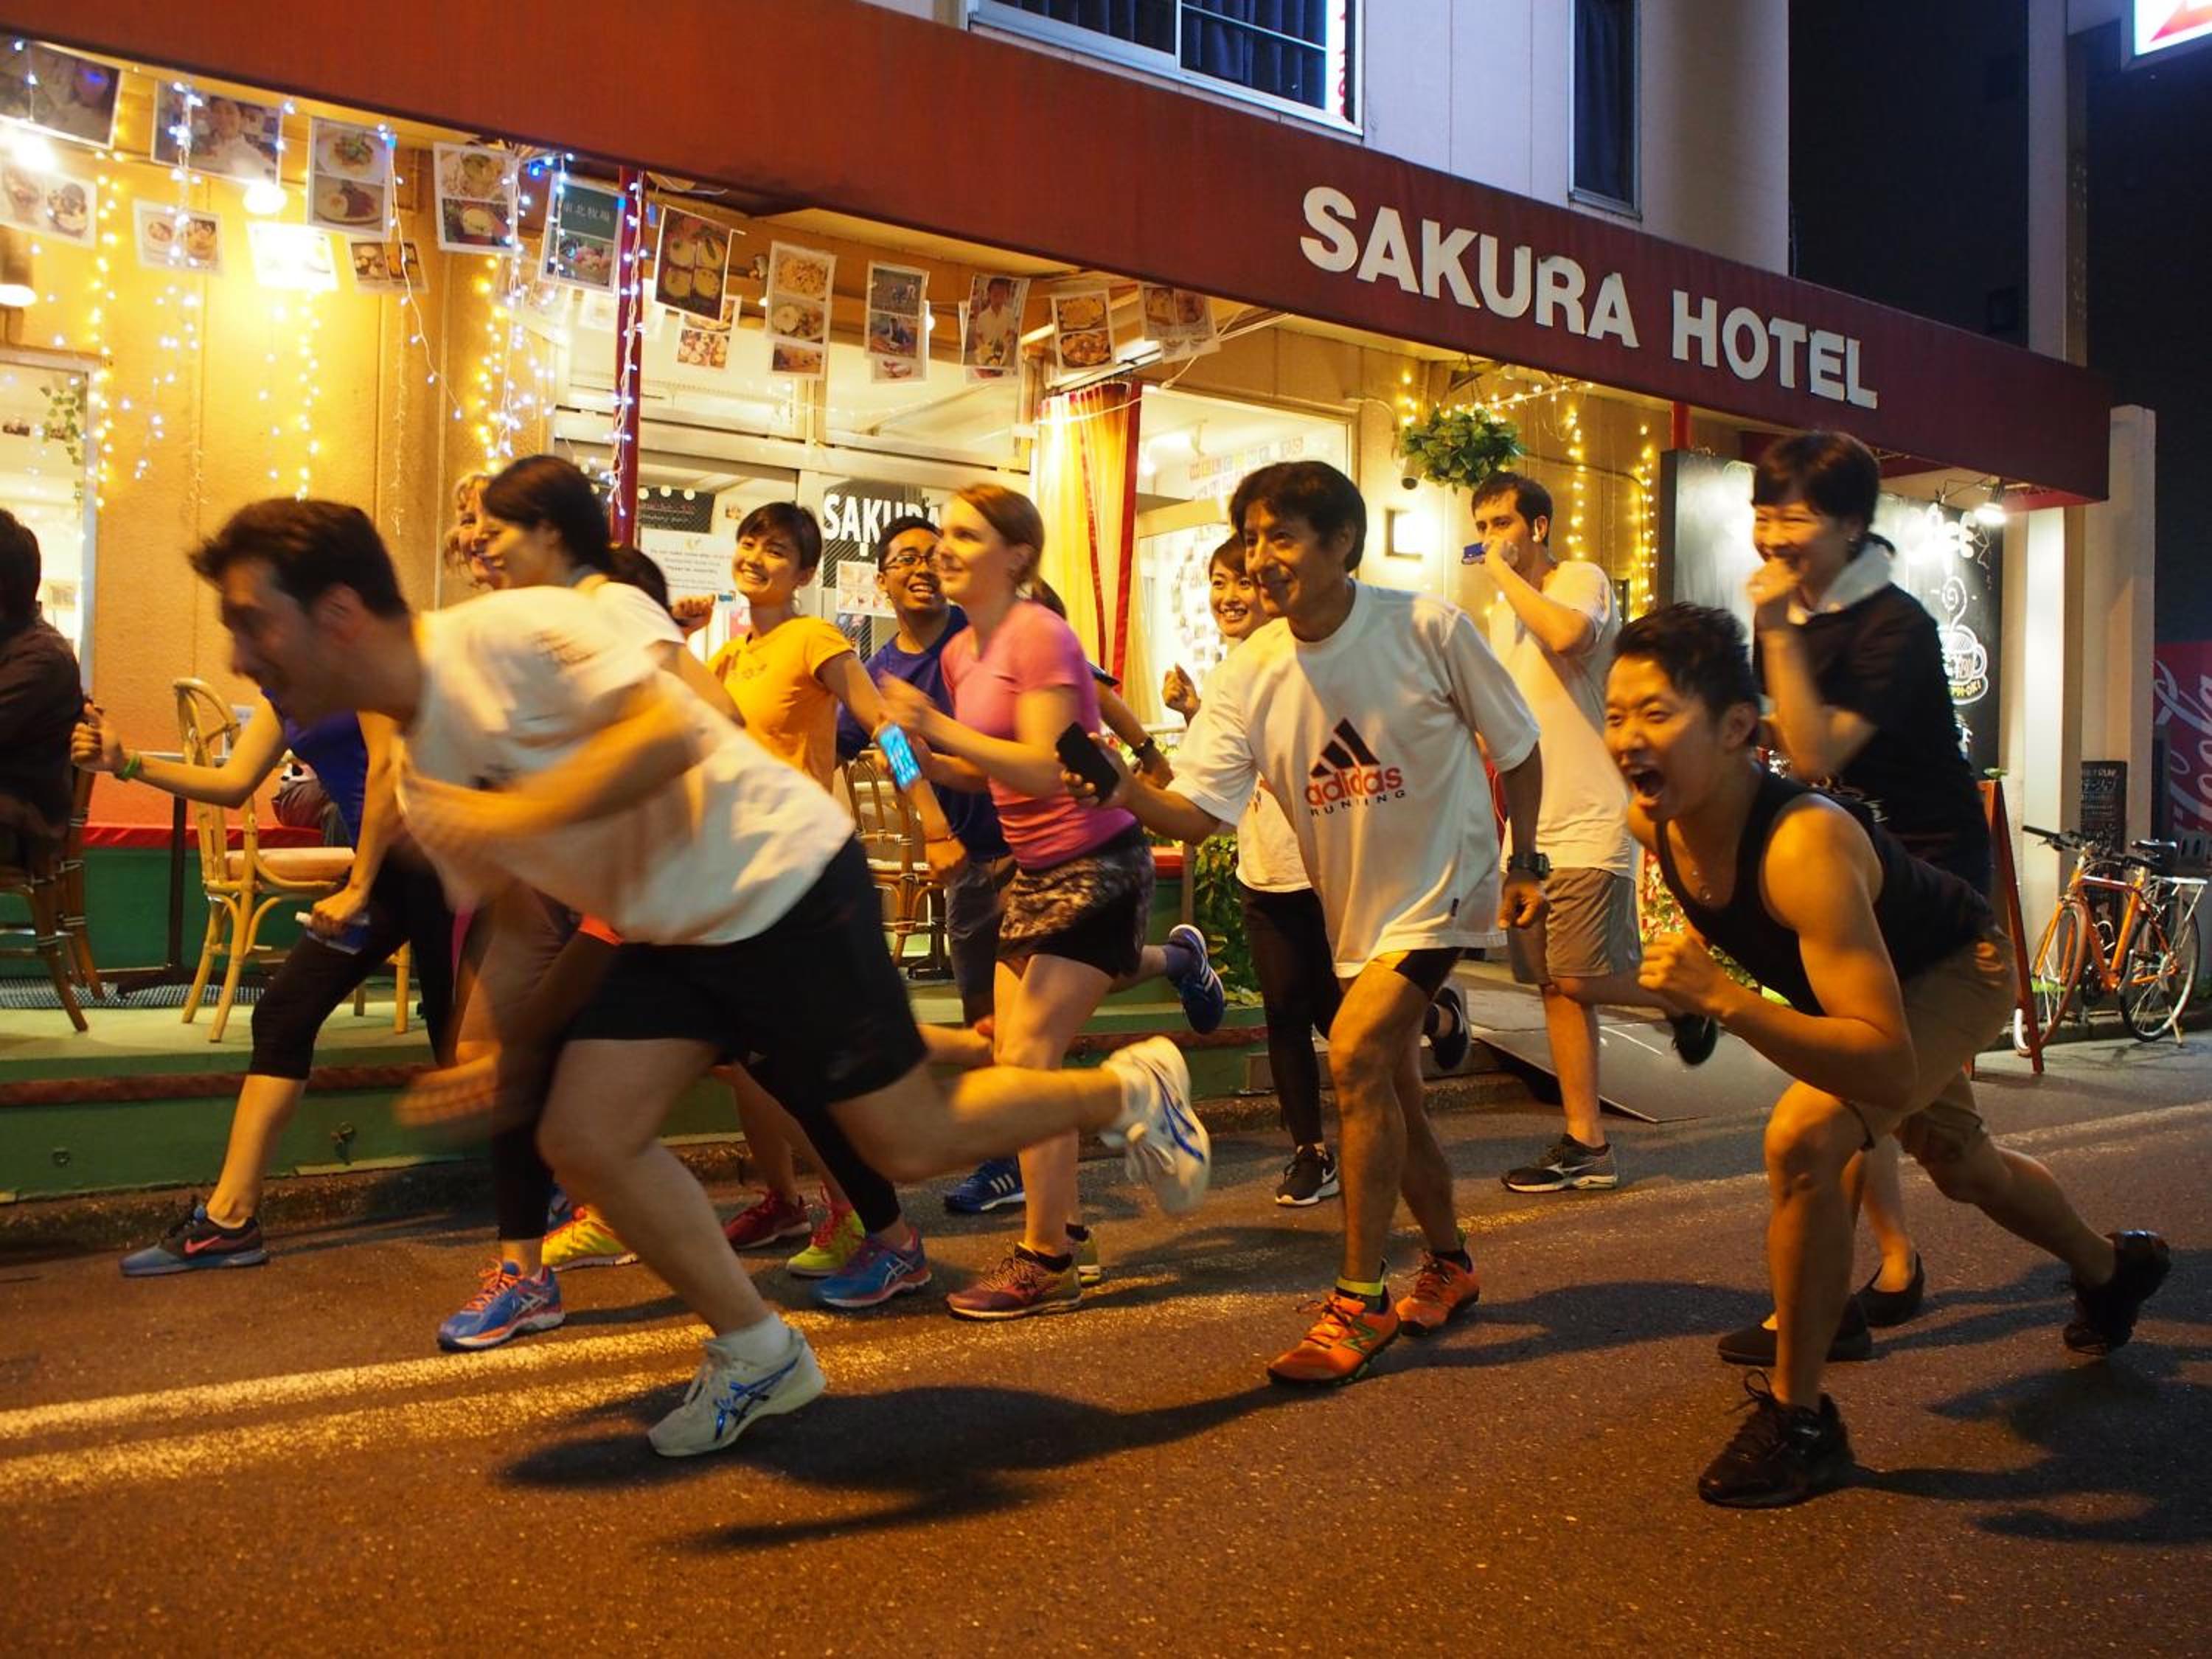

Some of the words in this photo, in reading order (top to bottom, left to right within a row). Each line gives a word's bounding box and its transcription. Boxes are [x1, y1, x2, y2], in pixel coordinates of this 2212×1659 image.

[1300, 185, 1641, 349] SAKURA
[1672, 289, 1878, 410] HOTEL
[1304, 767, 1403, 807] adidas
